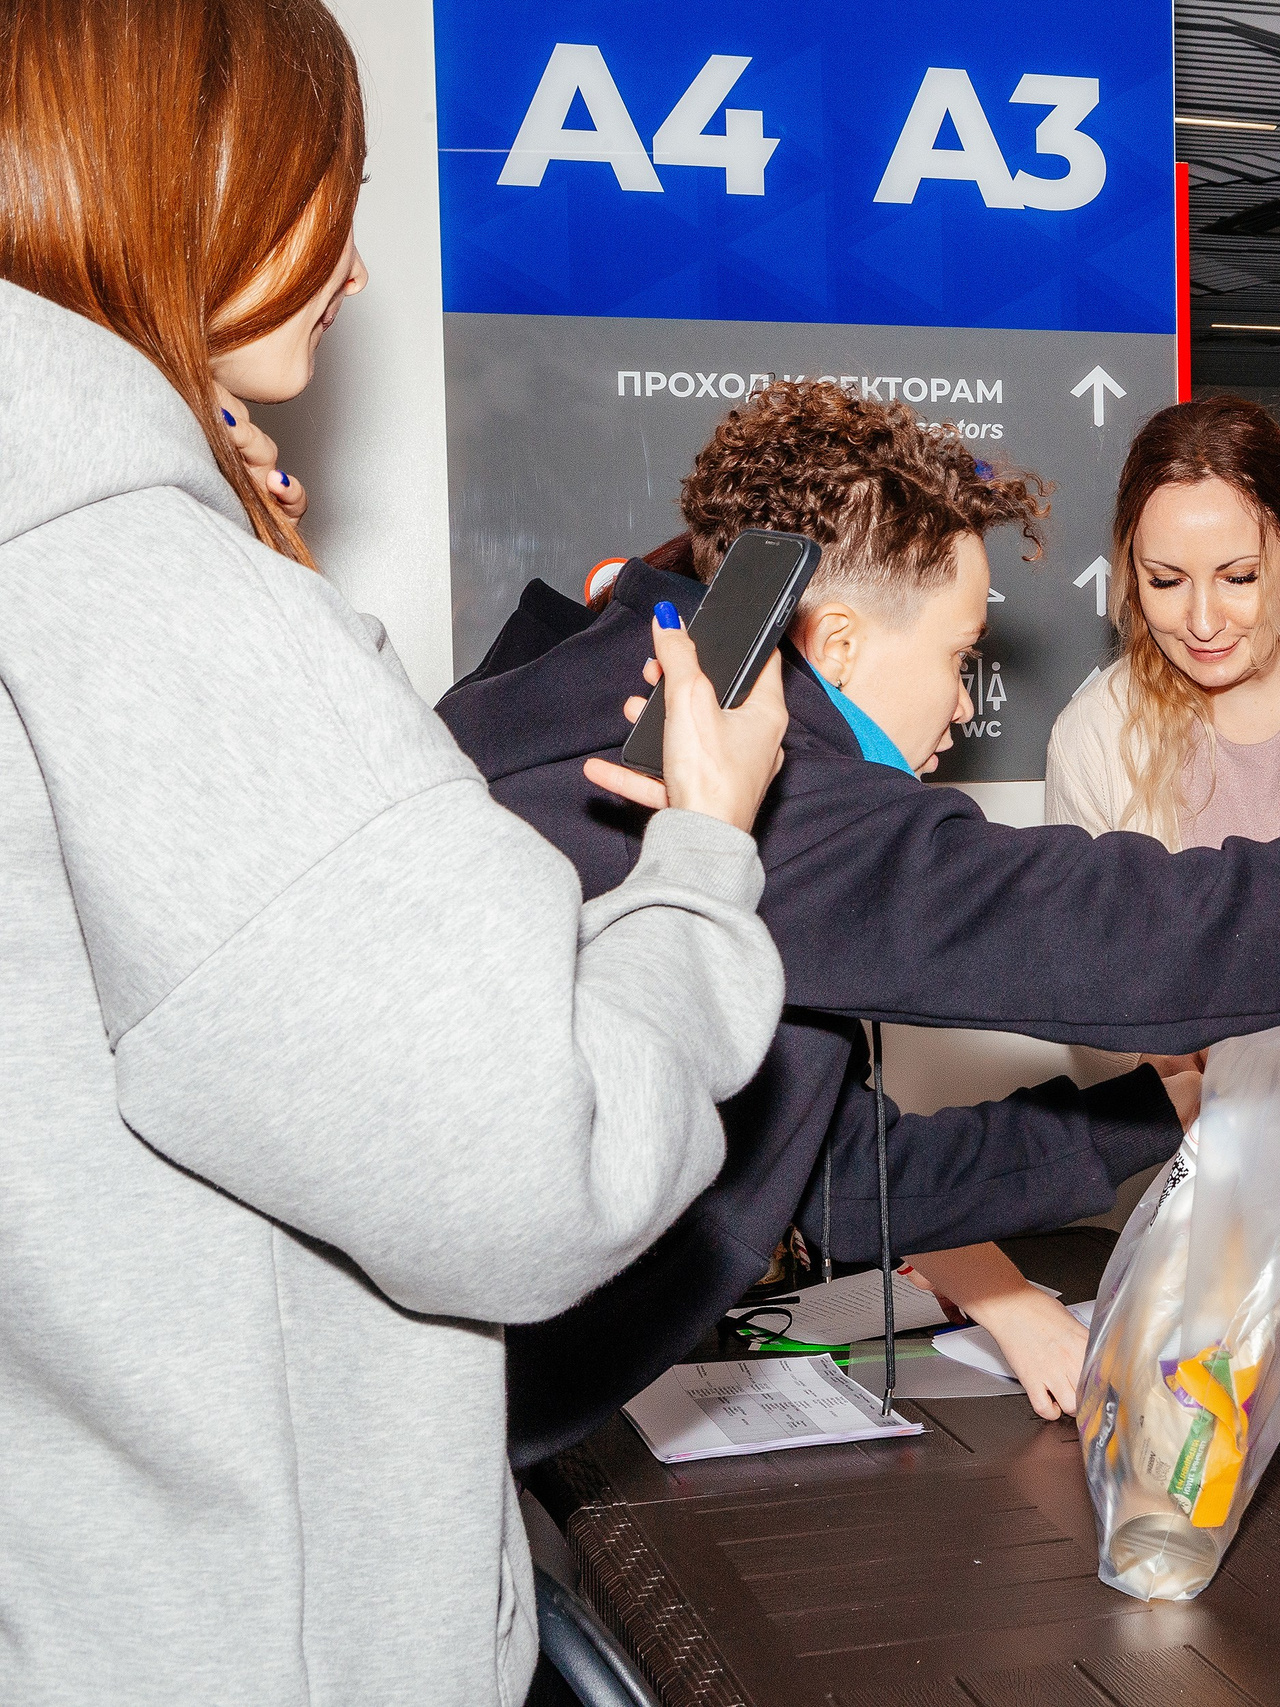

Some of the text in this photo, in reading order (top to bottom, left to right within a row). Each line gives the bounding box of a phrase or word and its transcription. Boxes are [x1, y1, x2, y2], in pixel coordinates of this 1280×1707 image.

[497, 43, 1107, 212] A4 A3
[960, 720, 1002, 738] WC
